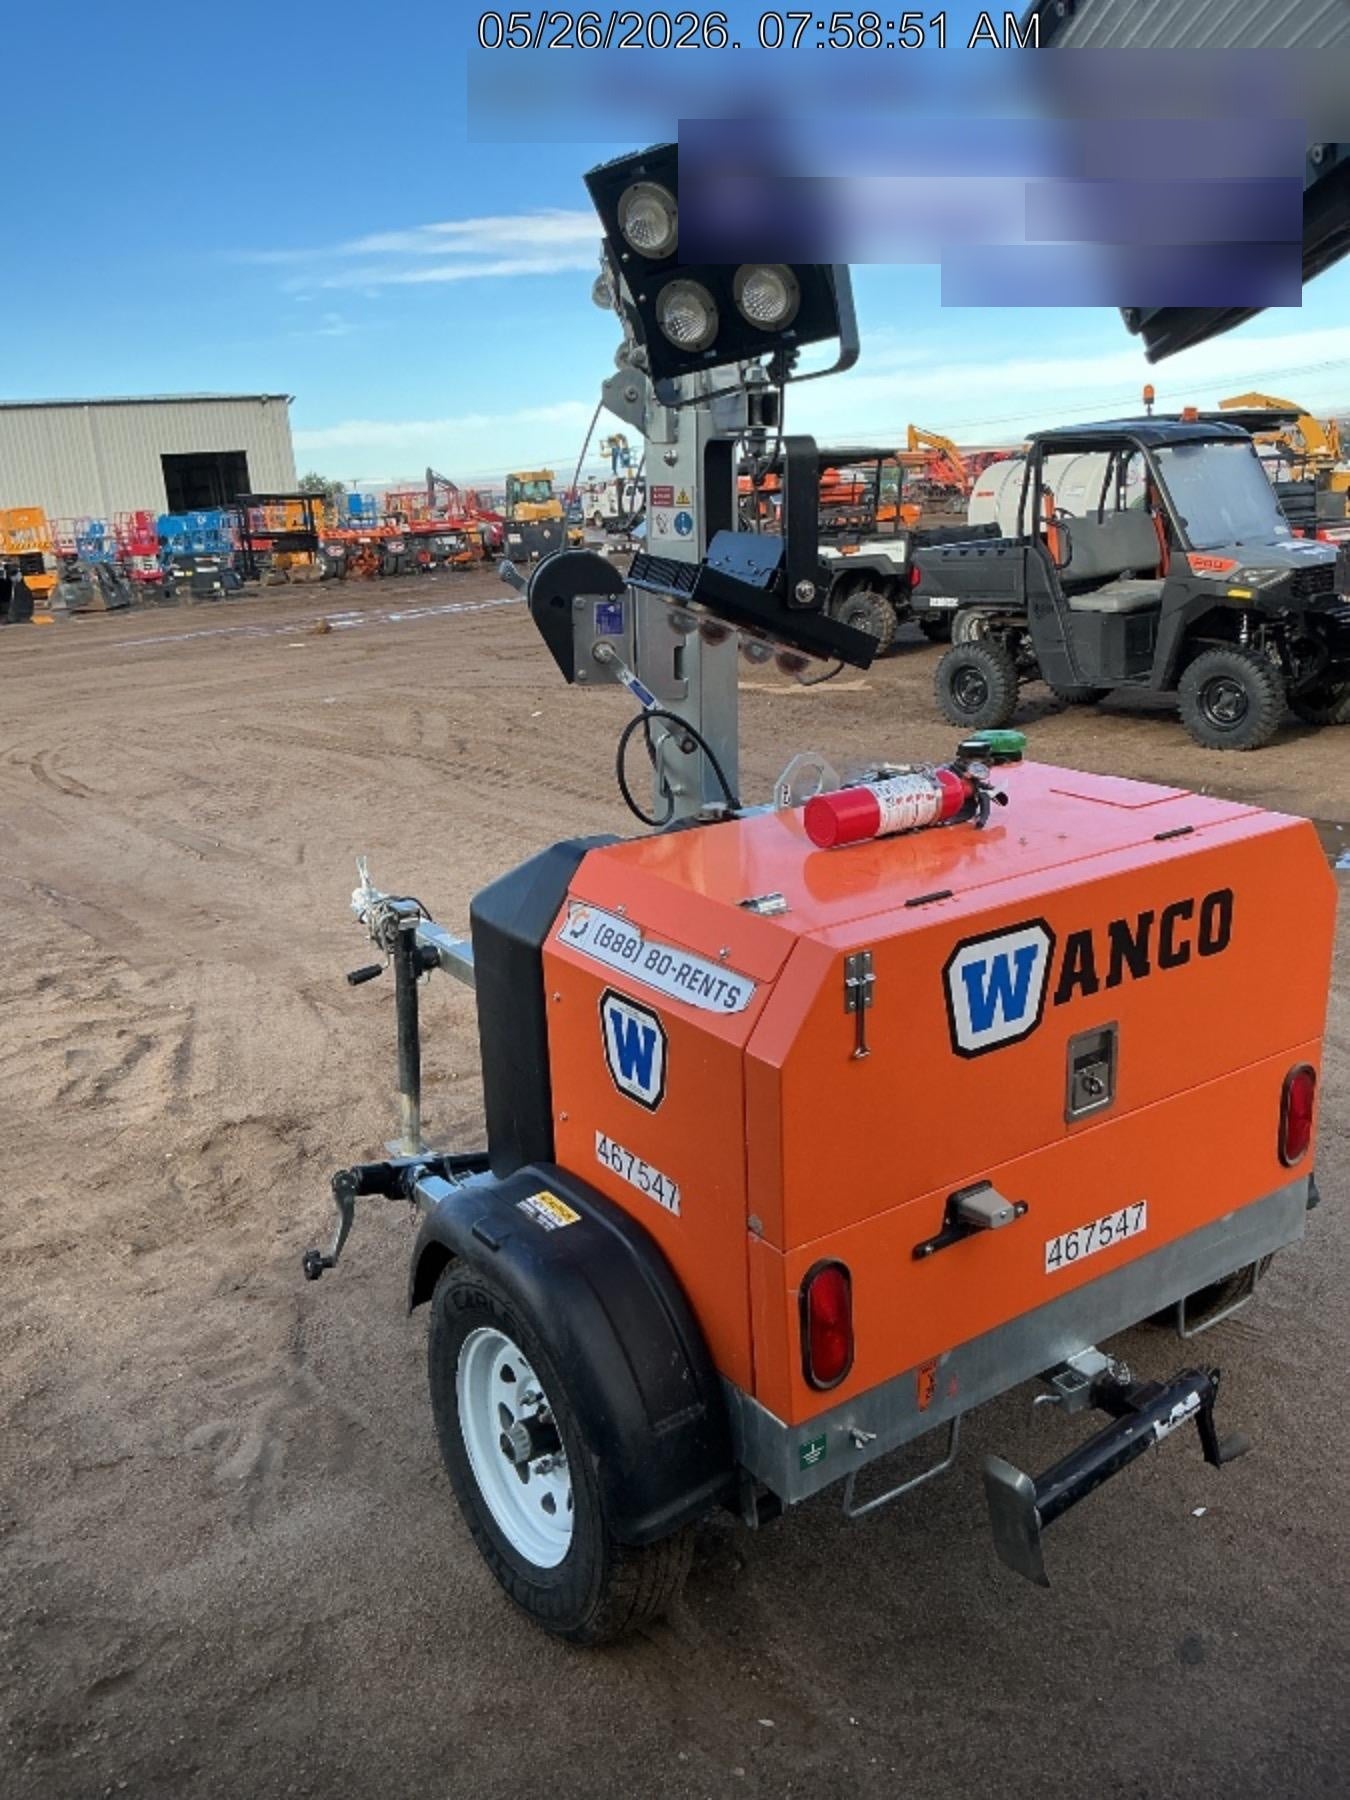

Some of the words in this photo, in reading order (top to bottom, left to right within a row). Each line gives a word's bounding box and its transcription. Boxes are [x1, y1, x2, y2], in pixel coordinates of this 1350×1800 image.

[593, 921, 645, 963] (888)
[644, 946, 741, 1009] 80-RENTS
[961, 888, 1233, 1034] WANCO
[597, 1138, 678, 1209] 467547
[1047, 1202, 1144, 1266] 467547
